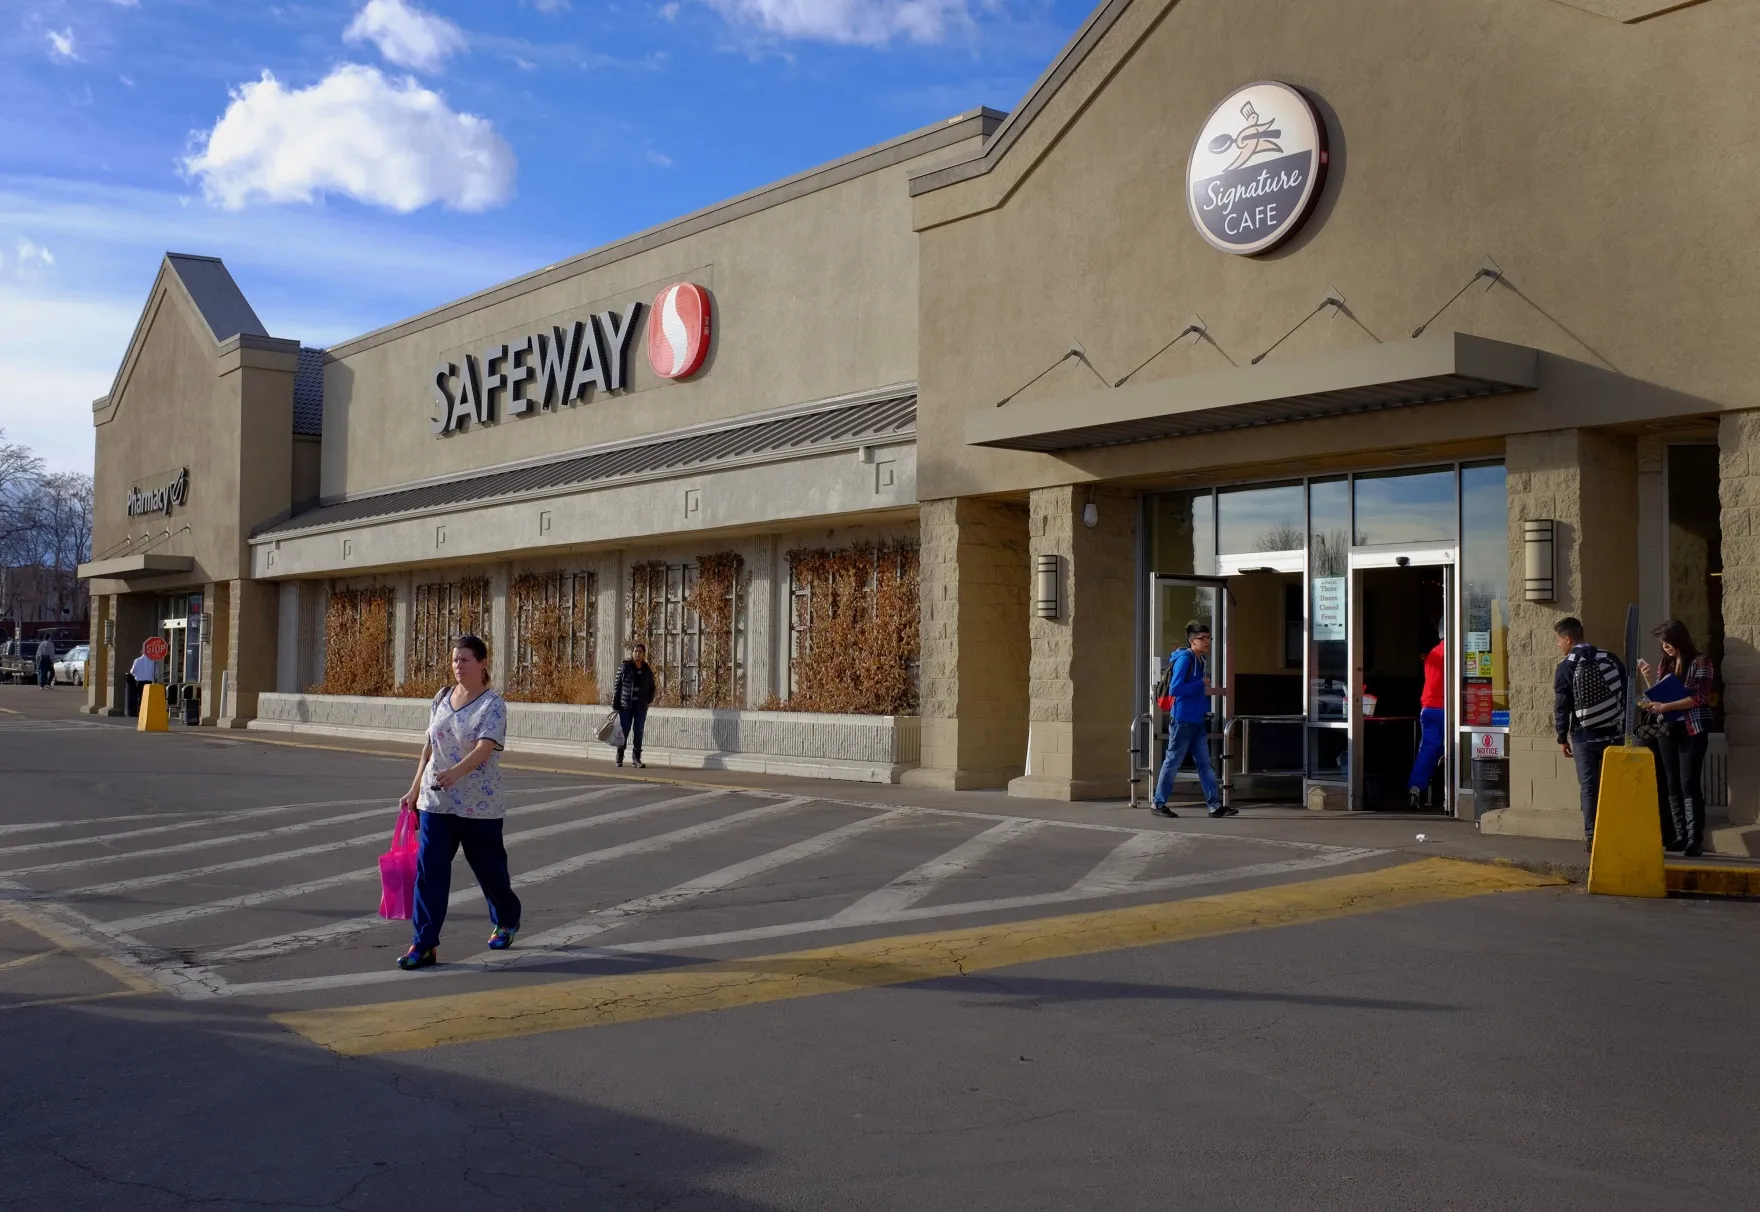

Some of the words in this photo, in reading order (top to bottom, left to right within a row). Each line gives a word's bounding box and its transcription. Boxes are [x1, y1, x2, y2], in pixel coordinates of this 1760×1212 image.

[1203, 169, 1302, 214] Signature
[1224, 203, 1277, 235] CAFE
[431, 301, 643, 435] SAFEWAY
[127, 486, 170, 517] Pharmacy
[146, 644, 166, 654] STOP
[1476, 747, 1499, 755] NOTICE
